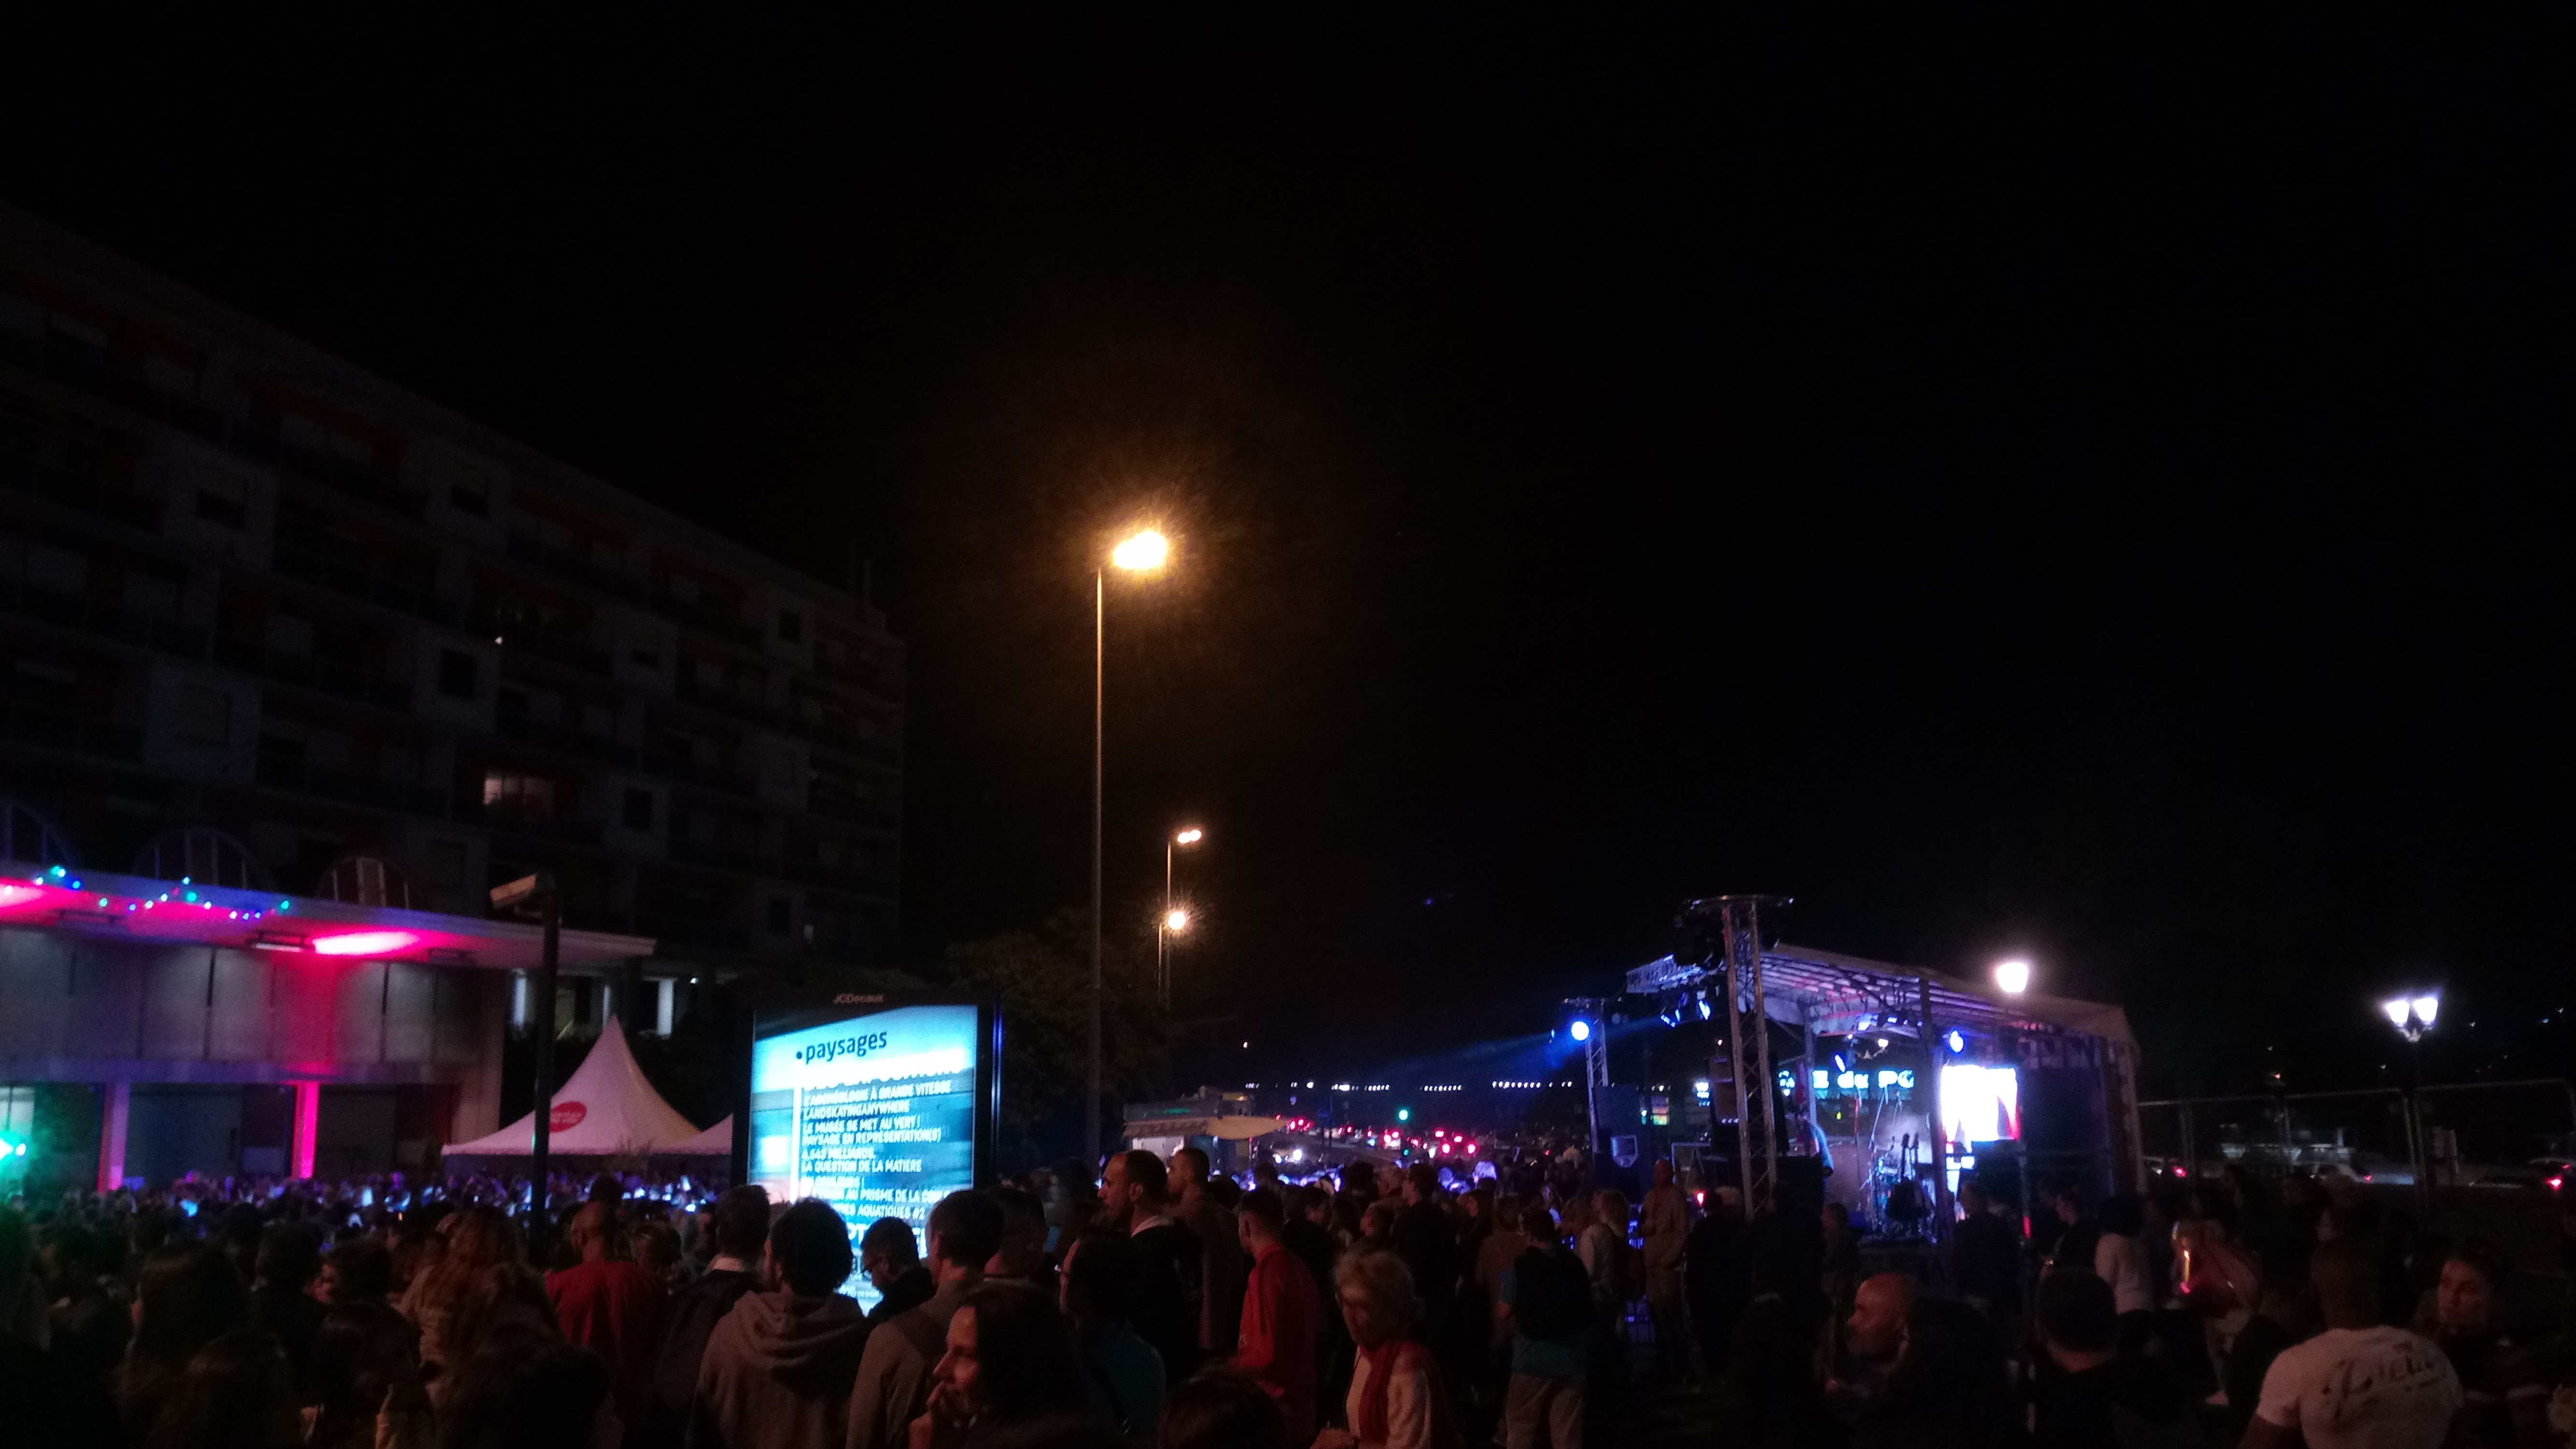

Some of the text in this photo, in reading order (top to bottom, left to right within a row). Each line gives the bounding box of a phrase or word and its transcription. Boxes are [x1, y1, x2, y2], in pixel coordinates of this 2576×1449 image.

[805, 1030, 888, 1065] paysages
[860, 1117, 878, 1131] MET
[880, 1116, 892, 1130] AU
[801, 1160, 812, 1173] LA
[858, 1160, 870, 1172] DE
[872, 1160, 883, 1172] LA
[860, 1188, 894, 1202] PRISME
[895, 1189, 907, 1202] DE
[909, 1189, 920, 1203] LA
[857, 1203, 911, 1219] AQUATIQUES
